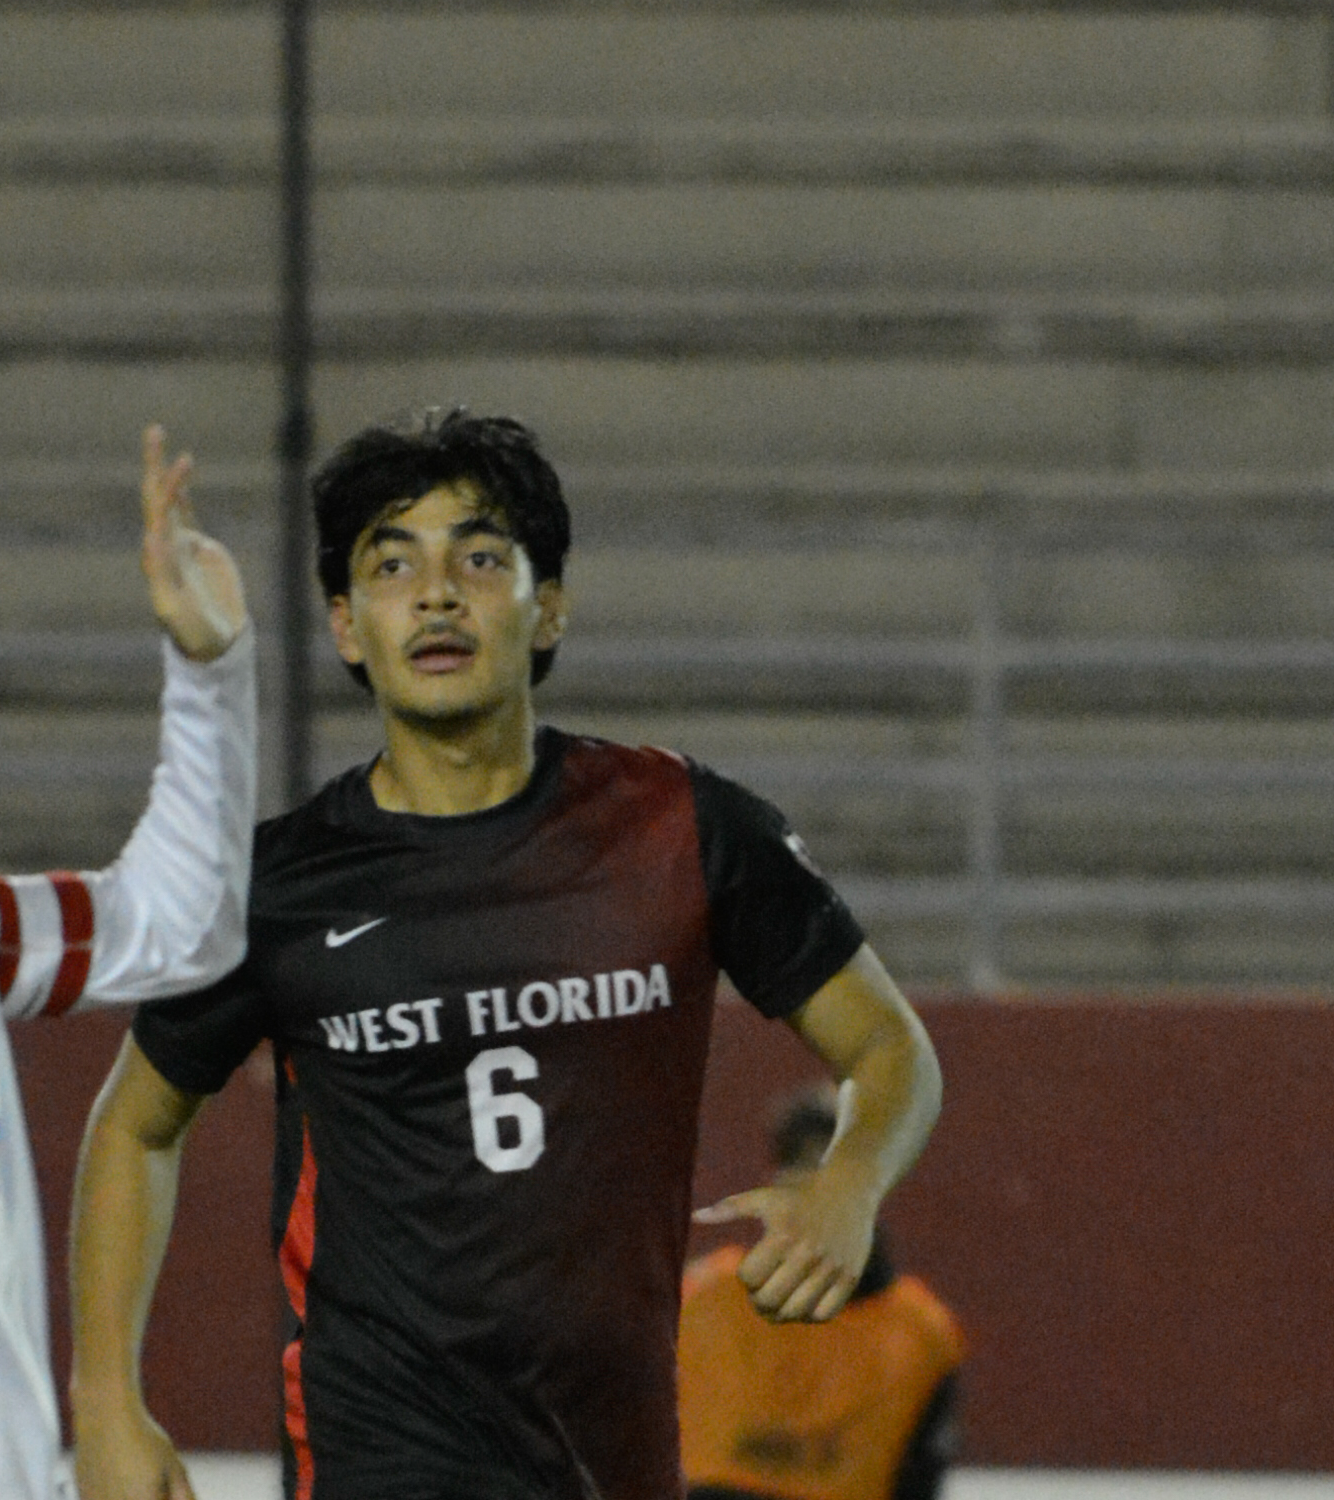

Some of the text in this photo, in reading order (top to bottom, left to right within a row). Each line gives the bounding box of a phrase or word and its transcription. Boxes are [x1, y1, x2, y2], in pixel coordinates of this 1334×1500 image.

[319, 963, 672, 1053] WEST FLORIDA
[465, 1046, 546, 1173] 6
